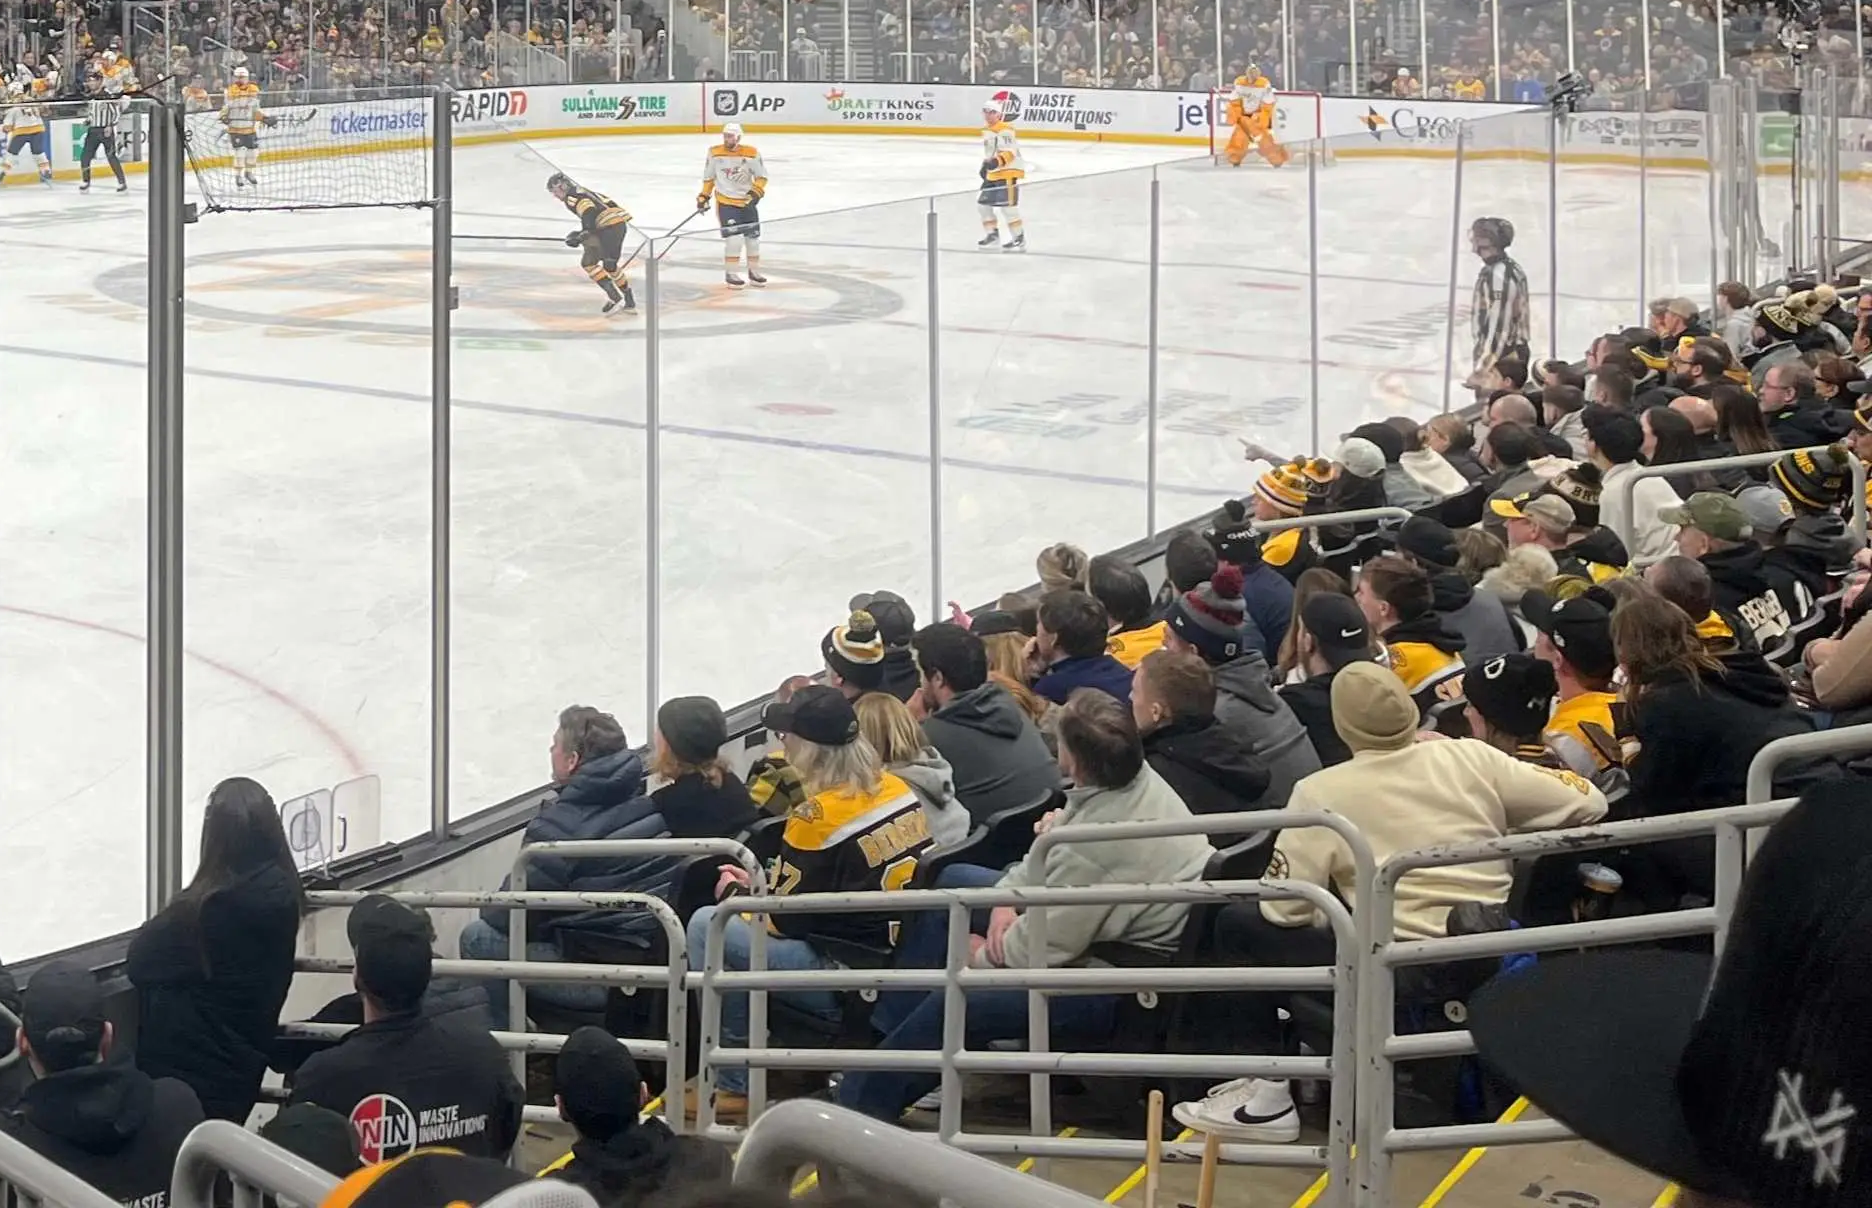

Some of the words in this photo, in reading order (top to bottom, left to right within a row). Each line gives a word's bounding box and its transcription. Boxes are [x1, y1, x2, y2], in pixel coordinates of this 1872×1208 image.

[451, 91, 528, 122] RAPID7
[562, 95, 619, 112] SULLIVAN
[638, 95, 666, 110] TIRE
[1029, 94, 1076, 108] WASTE
[330, 108, 427, 135] ticketmaster
[842, 111, 923, 122] SPORTSBOOK
[1023, 108, 1113, 127] INNOVATIONS
[418, 1105, 459, 1126] WASTE
[417, 1114, 487, 1143] INNOVATIONS
